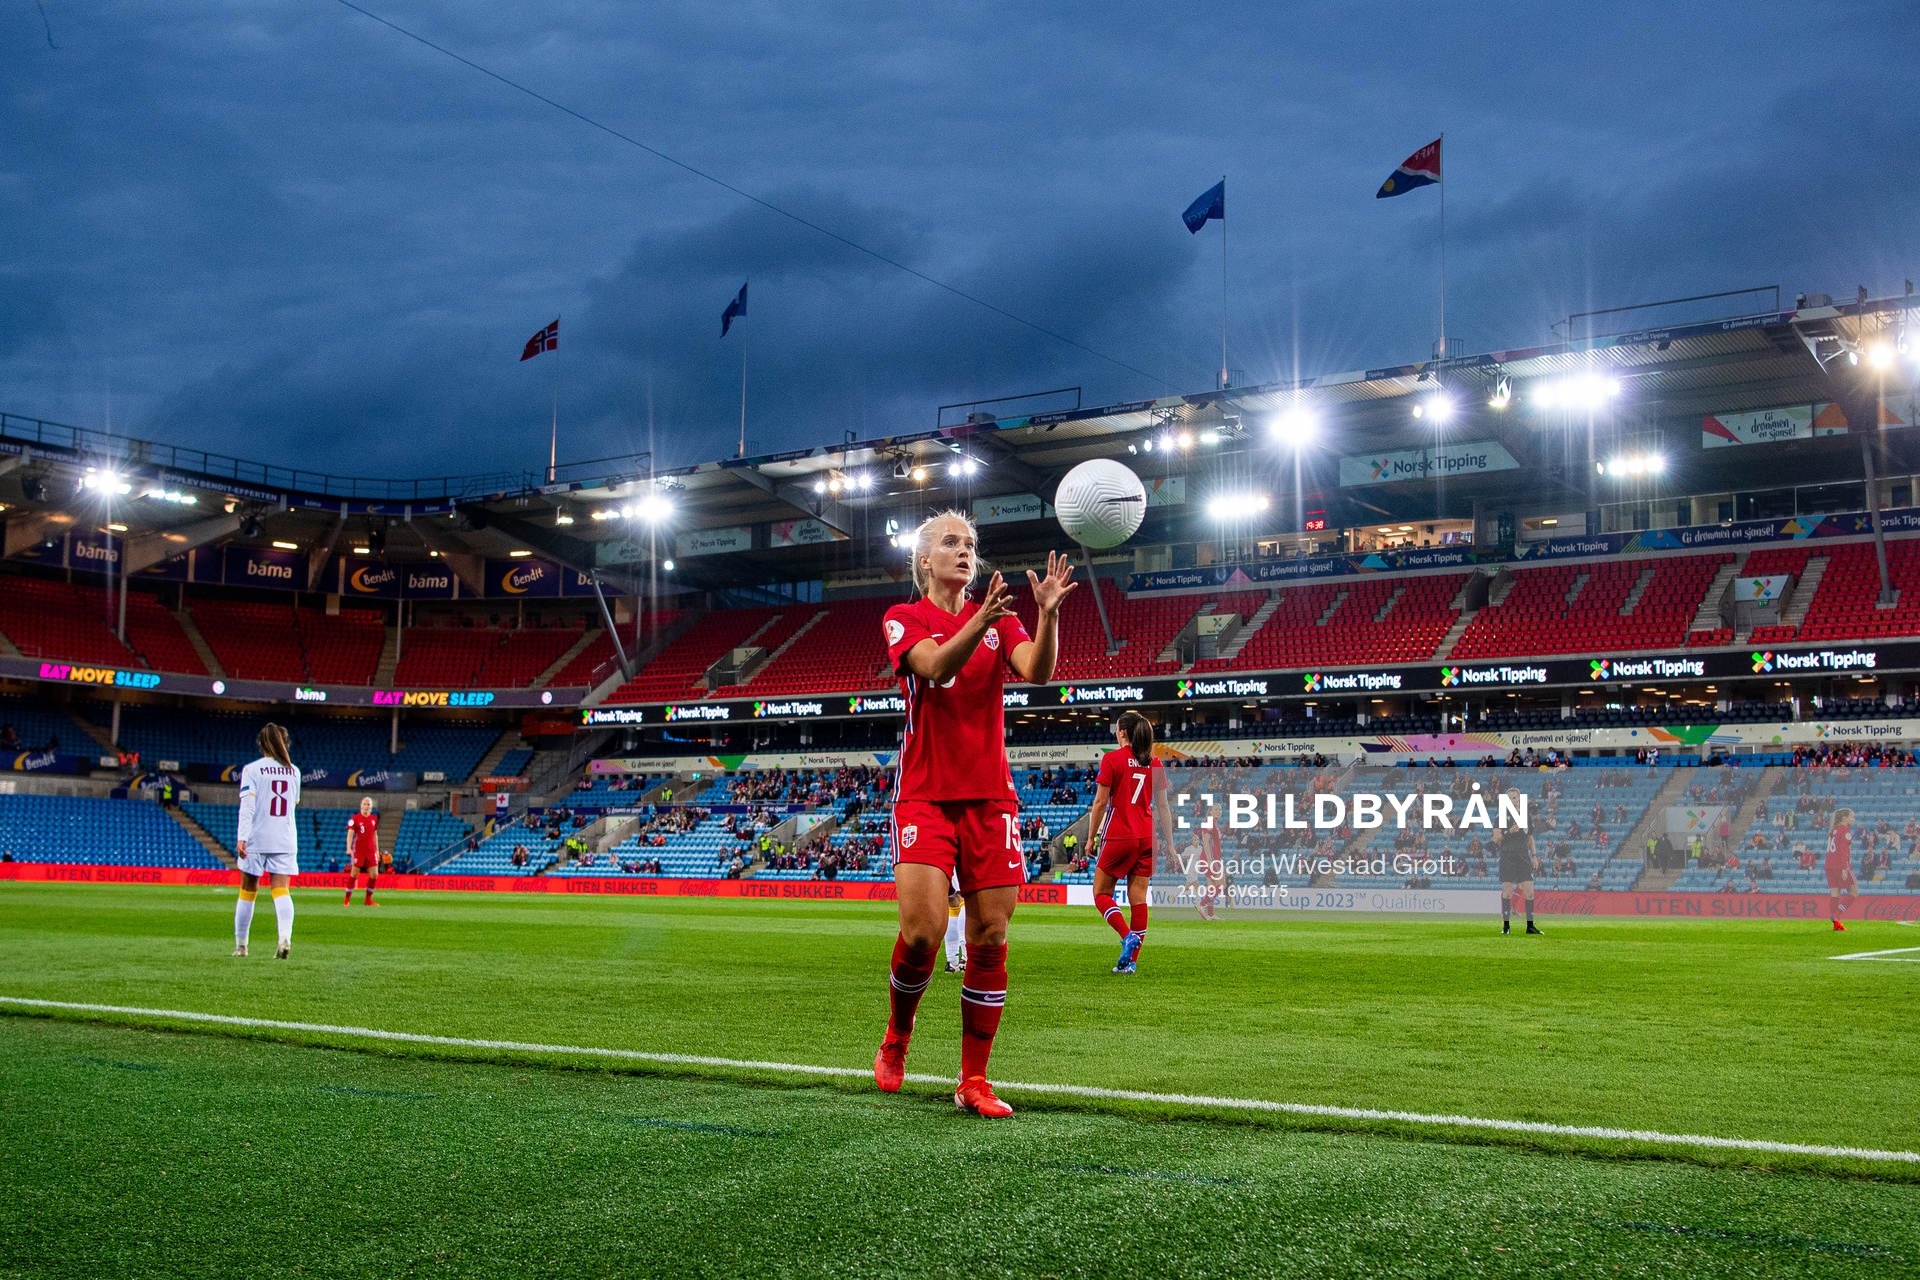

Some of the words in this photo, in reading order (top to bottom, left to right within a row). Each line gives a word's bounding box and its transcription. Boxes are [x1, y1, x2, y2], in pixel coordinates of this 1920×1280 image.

[1764, 412, 1774, 421] Gi
[1394, 460, 1433, 474] Norsk
[1435, 453, 1487, 471] Tipping
[1002, 506, 1022, 514] Norsk
[1880, 516, 1902, 527] orsk
[1681, 532, 1692, 544] Gi
[1731, 530, 1742, 538] en
[1744, 524, 1775, 540] sjanse!
[76, 540, 119, 562] bama
[1551, 544, 1576, 553] Norsk
[1577, 541, 1609, 553] Tipping
[1409, 555, 1432, 564] Norsk
[1433, 553, 1463, 565] Tipping
[247, 560, 293, 579] bama
[513, 567, 544, 586] Bendit
[363, 570, 396, 586] Bendit
[408, 574, 449, 588] bama
[1156, 577, 1176, 585] Norsk
[1177, 575, 1202, 584] Tipping
[1776, 653, 1819, 669] Norsk
[1819, 650, 1877, 669] Tipping
[1462, 668, 1499, 683] Norsk
[1499, 666, 1547, 684] Tipping
[1613, 661, 1652, 676] Norsk
[1652, 659, 1705, 678] Tipping
[70, 667, 115, 685] MOVE
[115, 671, 160, 689] SLEEP
[1323, 674, 1358, 689] Norsk
[1358, 673, 1402, 690] Tipping
[295, 688, 327, 702] bama
[1076, 688, 1105, 701] Norsk
[1105, 686, 1144, 701] Tipping
[1195, 681, 1227, 695] Norsk
[1226, 680, 1268, 696] Tipping
[403, 692, 449, 706] MOVE
[449, 692, 495, 706] SLEEP
[863, 698, 889, 711] Norsk
[1003, 691, 1029, 706] pping
[677, 706, 700, 719] Norsk
[700, 706, 730, 720] Tipping
[767, 703, 791, 715] Norsk
[791, 702, 822, 716] Tipping
[594, 711, 615, 722] Norsk
[615, 710, 643, 724] Tipping
[1832, 725, 1862, 736] Norsk
[1863, 724, 1902, 736] Tipping
[1264, 743, 1286, 752] Norsk
[1287, 742, 1315, 752] Tipping
[25, 751, 56, 770] Bendit
[825, 756, 846, 765] Tipping
[302, 768, 327, 783] endit
[359, 770, 390, 787] Bendit
[1131, 773, 1147, 805] 7
[270, 780, 288, 817] 8
[46, 868, 95, 881] UTEN
[96, 869, 162, 883] SUKKER
[415, 879, 444, 890] UTEN
[448, 879, 495, 891] SUKKER
[566, 881, 599, 894] UTEN
[604, 882, 658, 895] SUKKER
[739, 884, 778, 897] UTEN
[783, 885, 844, 899] SUKKER
[1279, 891, 1310, 910] Cup
[1371, 892, 1446, 912] Qualifiers
[1635, 897, 1706, 916] UTEN
[1711, 898, 1819, 917] SUKKER
